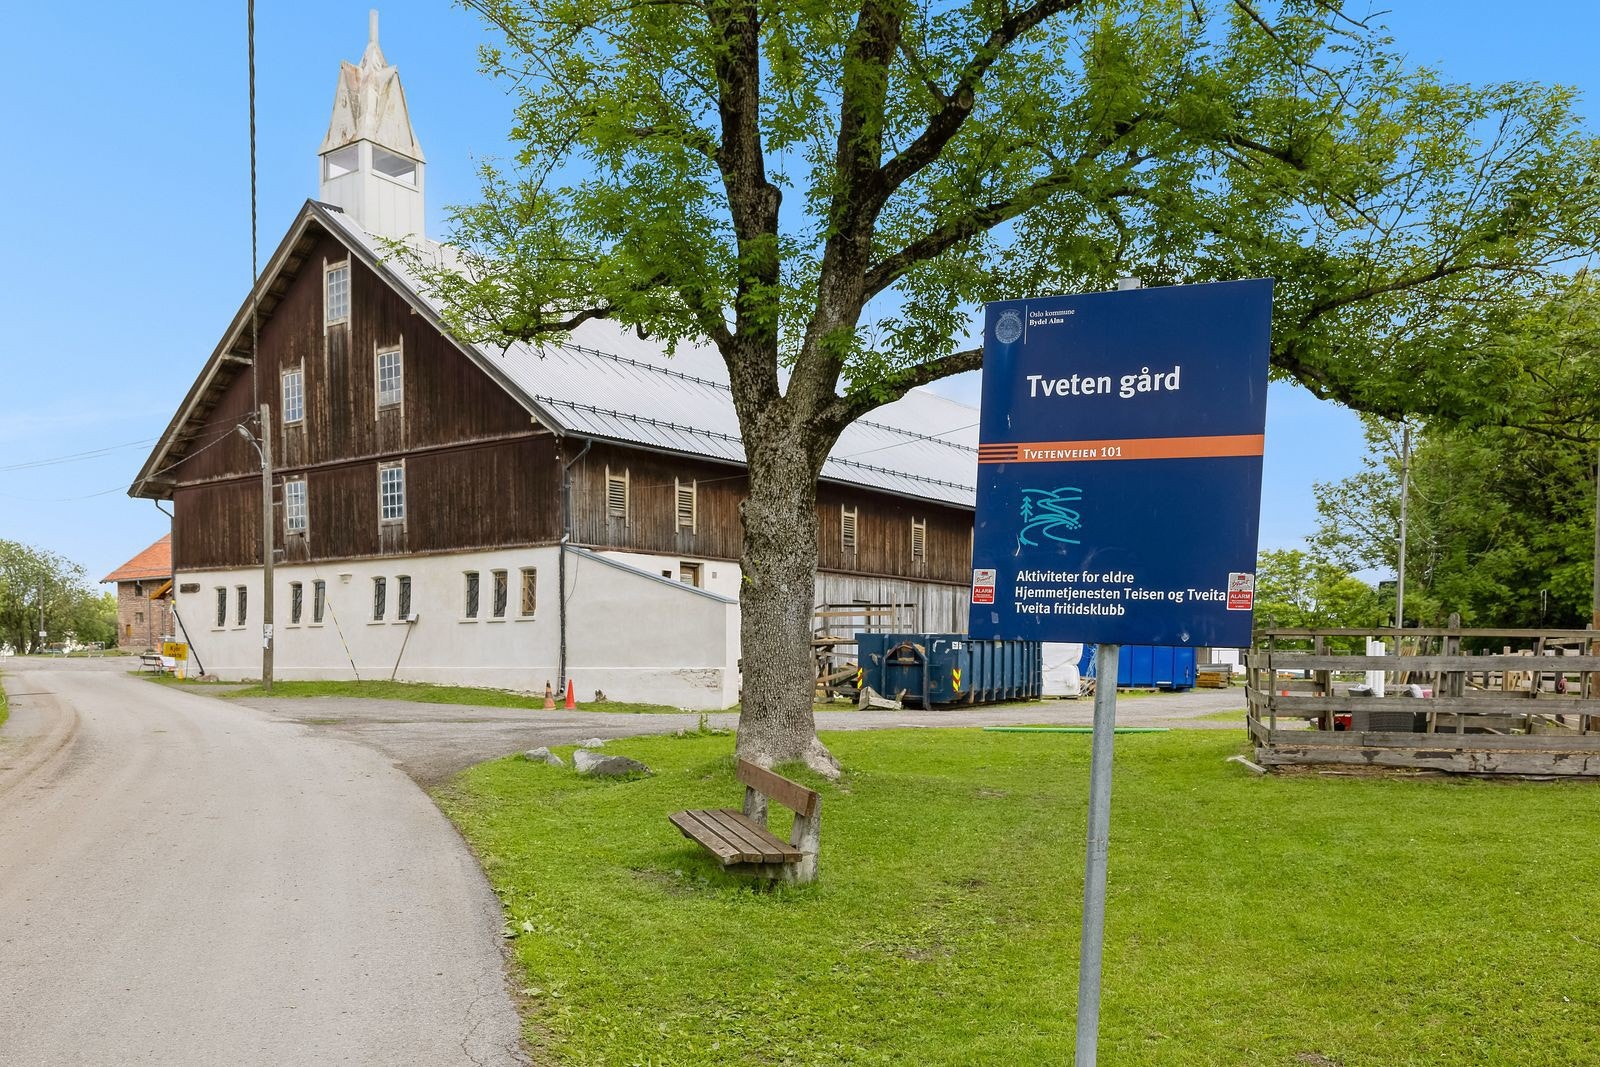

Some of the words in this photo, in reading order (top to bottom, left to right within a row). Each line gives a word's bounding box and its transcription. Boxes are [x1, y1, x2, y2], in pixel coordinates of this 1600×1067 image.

[1045, 309, 1075, 317] kommune
[1026, 374, 1111, 398] Tveten
[1119, 366, 1180, 398] gård
[1101, 446, 1122, 456] 101
[1016, 570, 1079, 582] Aktiviteter
[1082, 571, 1100, 582] for
[1102, 571, 1134, 583] eldre
[1014, 586, 1120, 601] Hjemmetjenesten
[1124, 588, 1164, 600] Teisen
[1168, 592, 1184, 602] og
[1187, 588, 1226, 600] Tveita
[1014, 602, 1050, 614] Tveita
[1054, 602, 1125, 616] fritidsklubb
